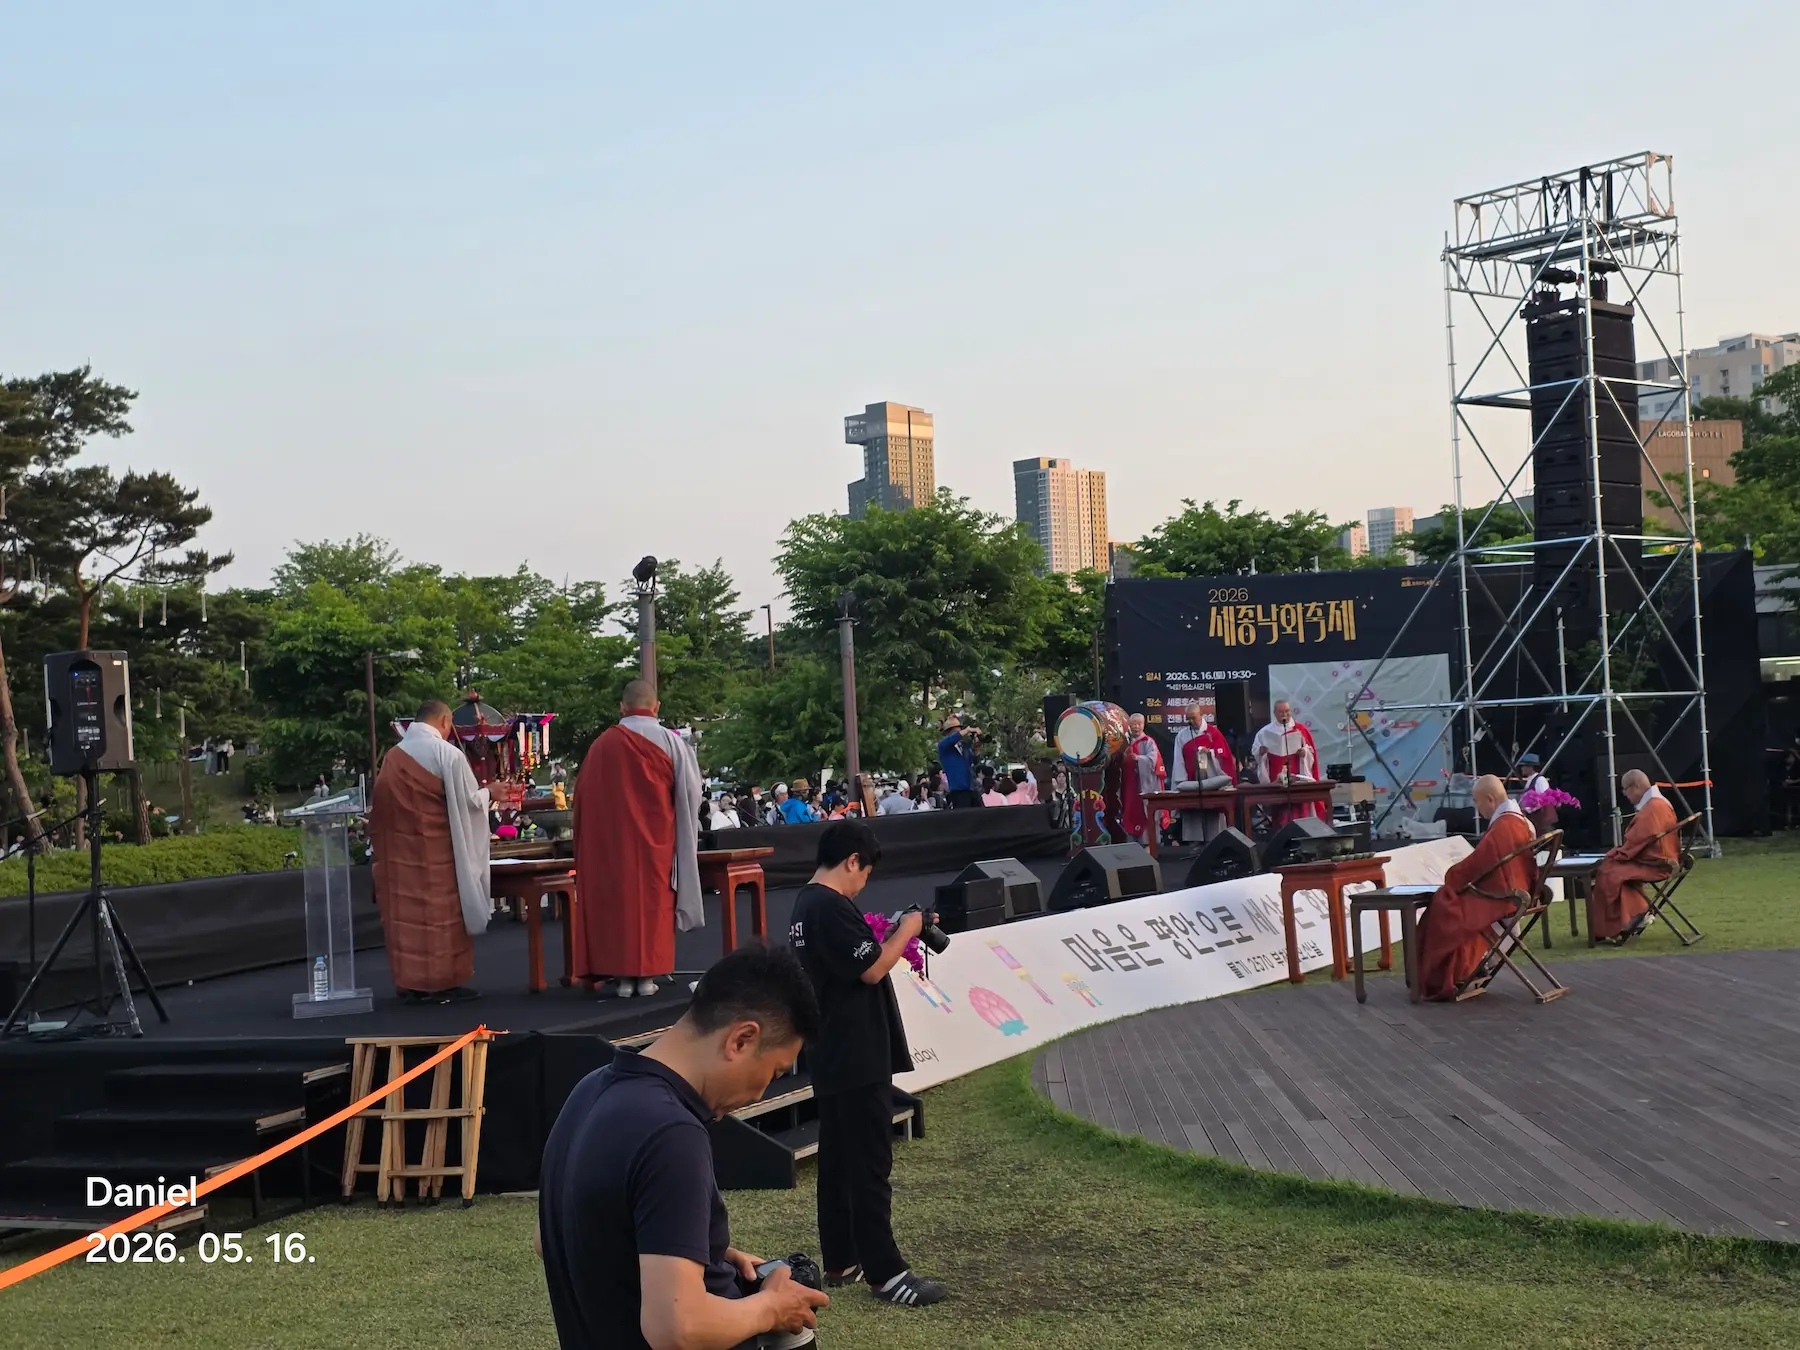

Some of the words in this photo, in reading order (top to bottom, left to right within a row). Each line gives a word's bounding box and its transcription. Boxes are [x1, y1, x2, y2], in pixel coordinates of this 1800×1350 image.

[1208, 587, 1249, 603] 2026
[1208, 600, 1357, 646] 세종낙화축제
[1166, 672, 1190, 681] 2026.
[1191, 671, 1200, 680] 5.
[1061, 924, 1164, 972] 마음은
[1144, 905, 1255, 960] 평안으로
[1225, 960, 1252, 979] 불기
[1246, 954, 1275, 972] 2570
